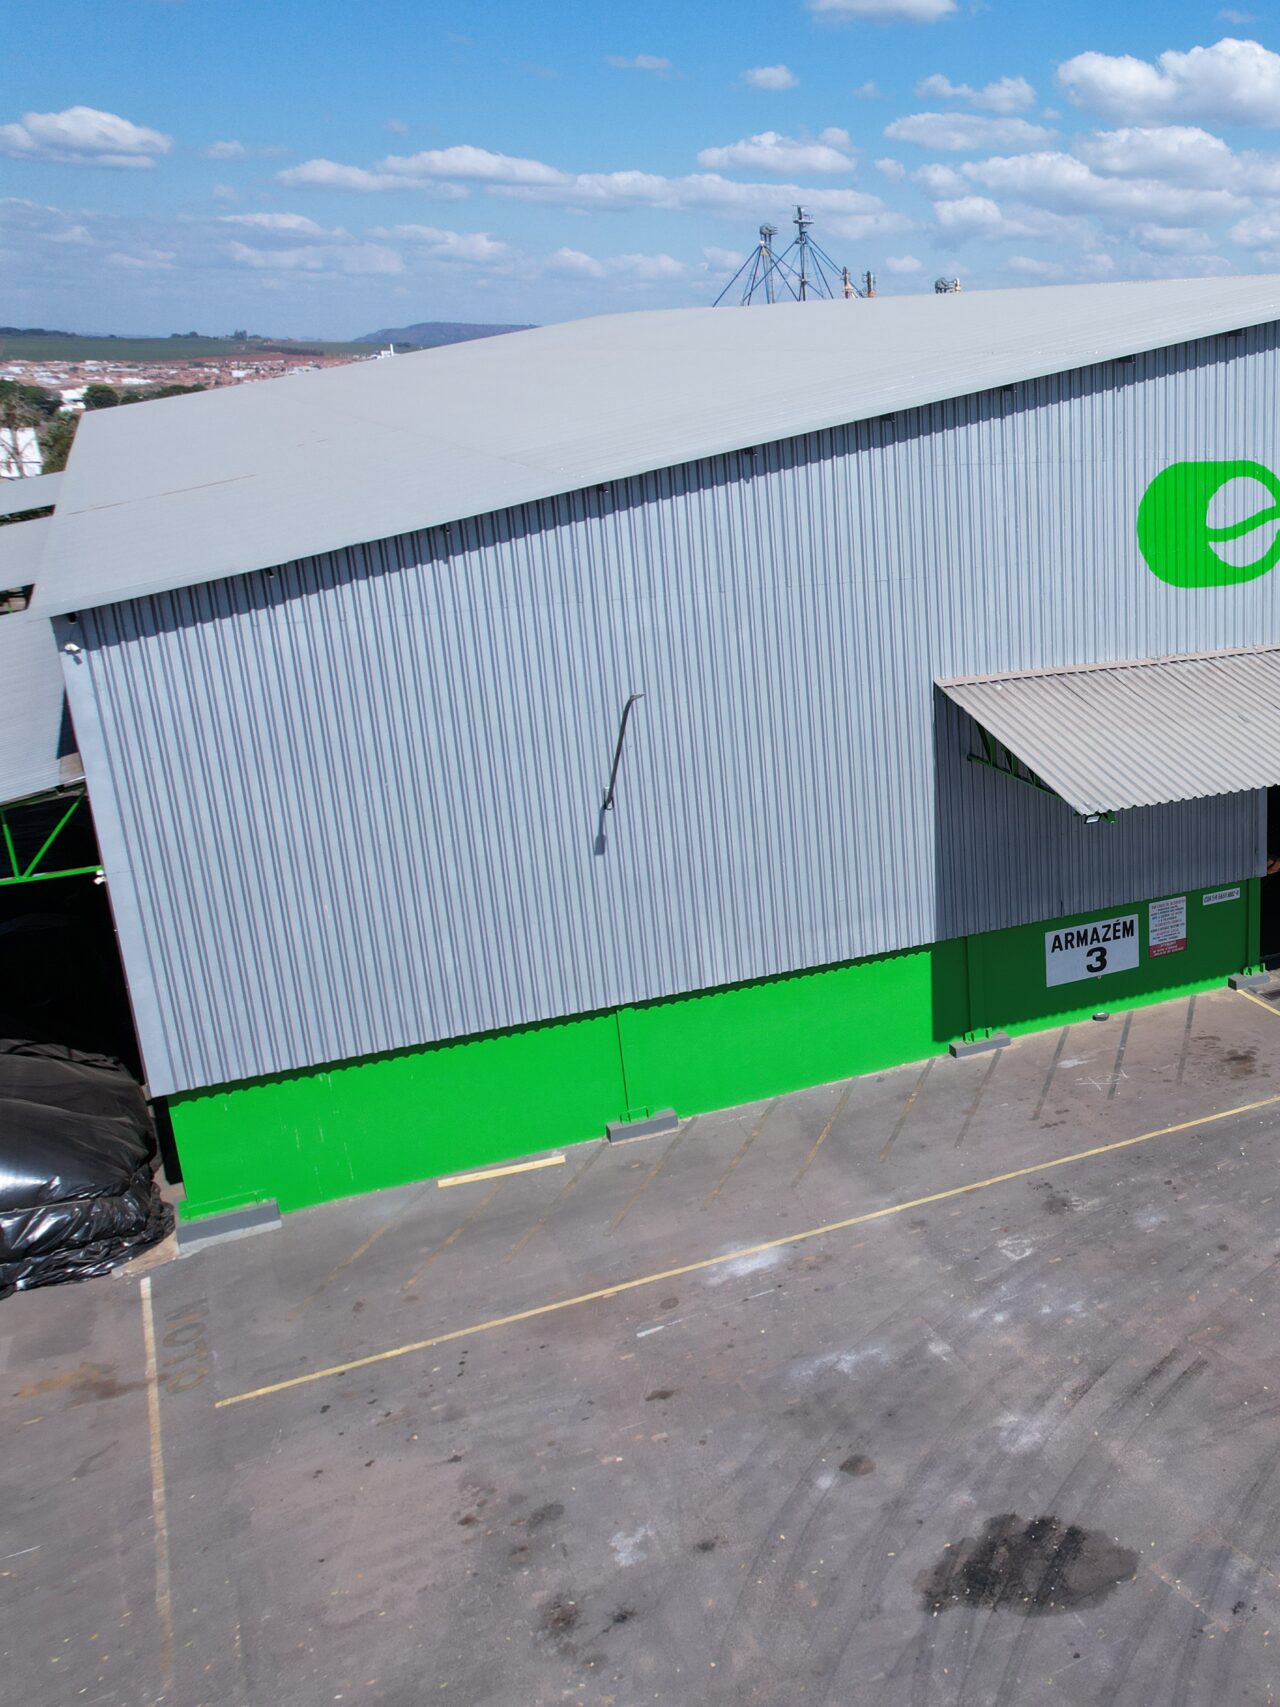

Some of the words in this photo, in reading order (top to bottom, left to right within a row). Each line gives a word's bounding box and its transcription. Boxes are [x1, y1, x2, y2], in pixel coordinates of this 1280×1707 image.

[1051, 919, 1135, 953] ARMAZÉM
[1086, 946, 1107, 973] 3
[163, 1298, 209, 1393] MOTO
